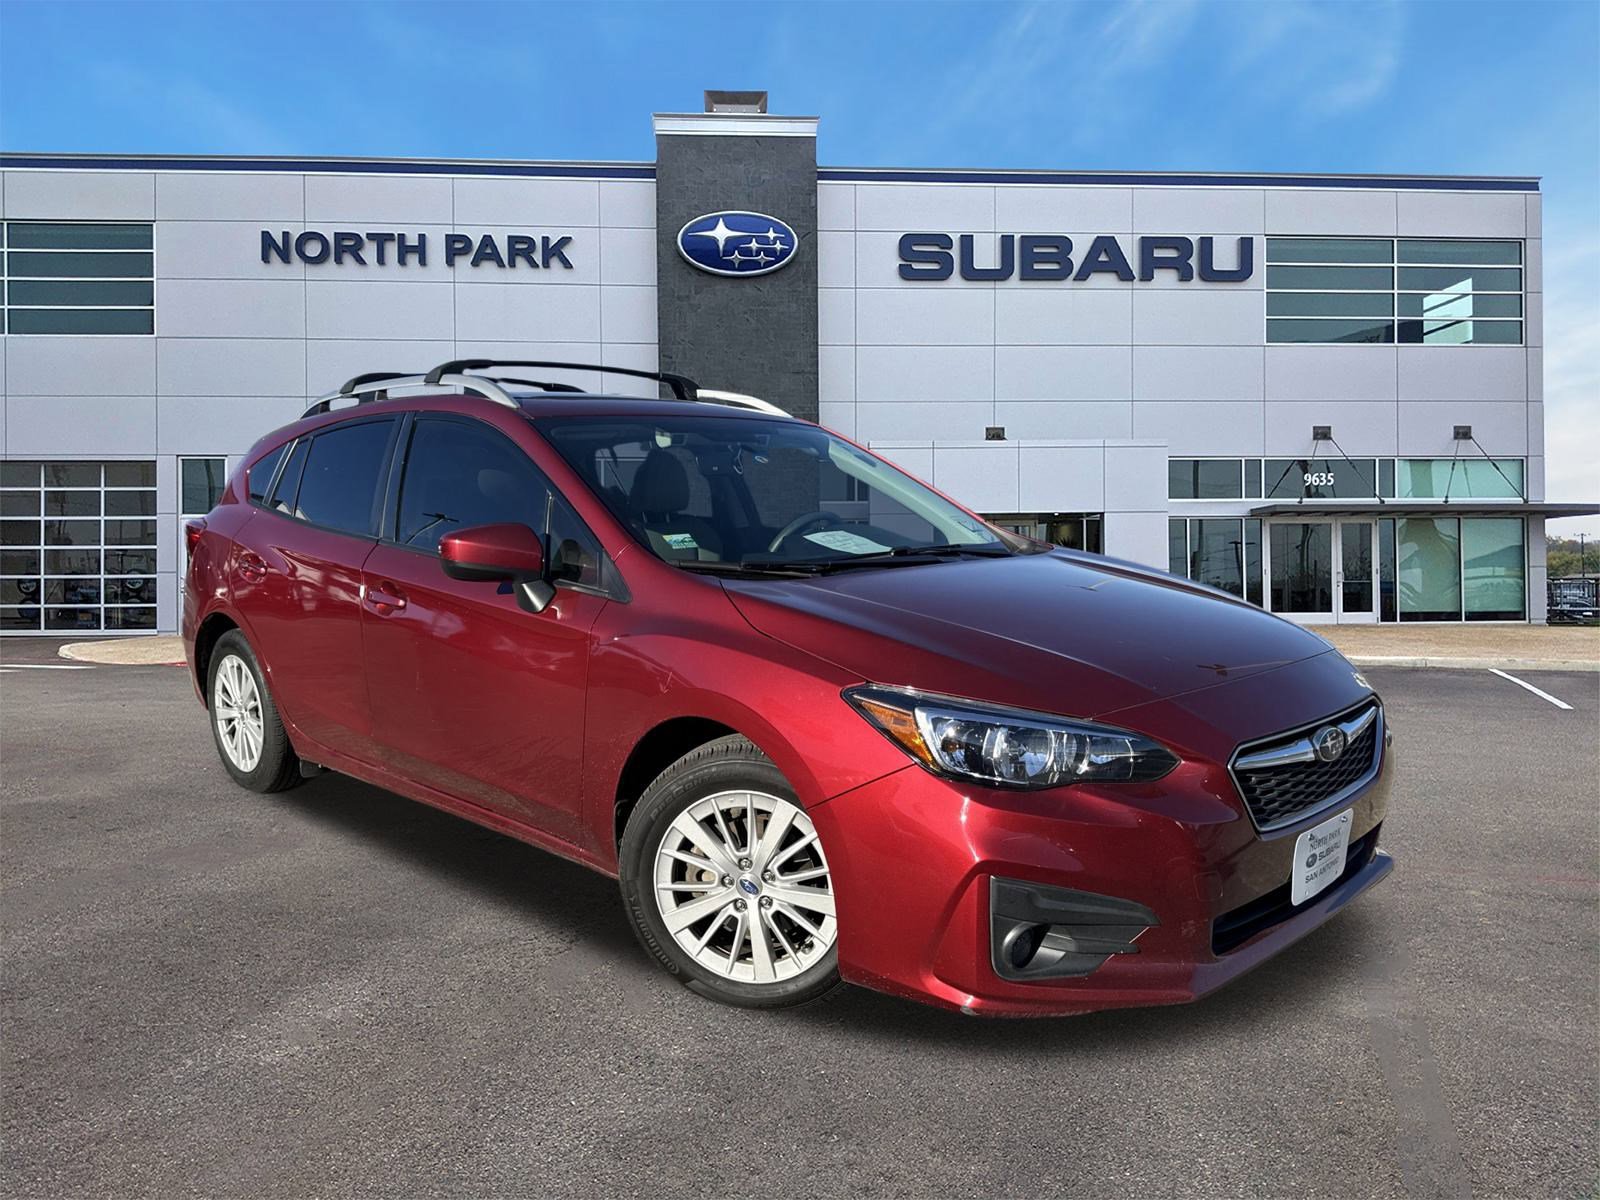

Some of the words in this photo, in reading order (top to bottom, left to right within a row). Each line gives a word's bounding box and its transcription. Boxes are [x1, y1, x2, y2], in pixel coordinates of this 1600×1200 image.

[261, 230, 427, 267] NORTH
[445, 233, 574, 269] PARK
[898, 232, 1255, 283] SUBARU
[1303, 472, 1335, 486] 9635
[1309, 836, 1328, 853] NORTH
[1318, 841, 1341, 861] SUBARU
[1305, 870, 1319, 884] SAN
